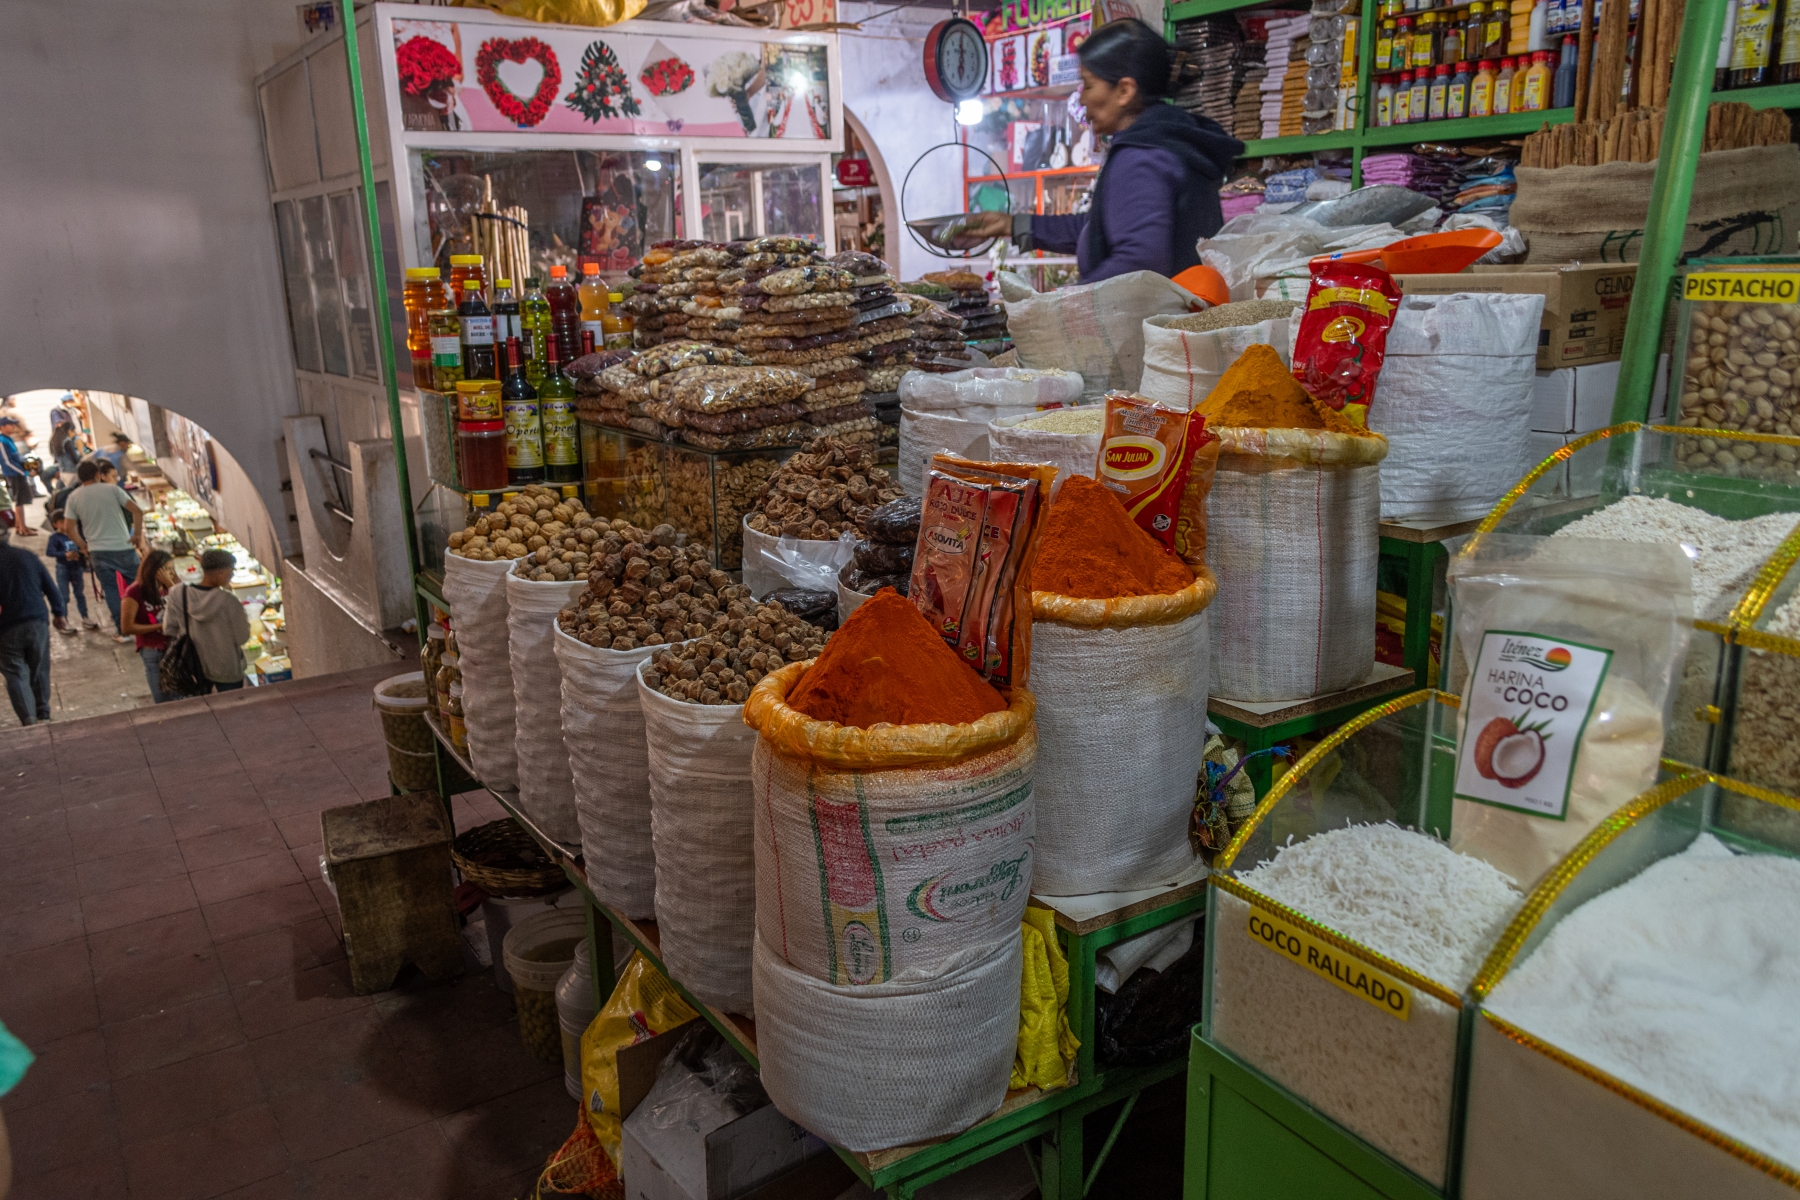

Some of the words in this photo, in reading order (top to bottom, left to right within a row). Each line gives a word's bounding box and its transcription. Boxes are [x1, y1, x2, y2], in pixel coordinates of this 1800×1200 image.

[1685, 278, 1795, 298] PISTACHO
[1106, 450, 1122, 462] SAN
[1122, 451, 1149, 463] JULIAN
[937, 484, 976, 507] AJI
[950, 506, 977, 521] DULCE
[927, 530, 965, 550] ASOVITA
[1487, 668, 1545, 689] HARINA
[1503, 686, 1568, 711] COCO
[1249, 916, 1301, 956] COCO
[1308, 945, 1404, 1011] RALLADO
